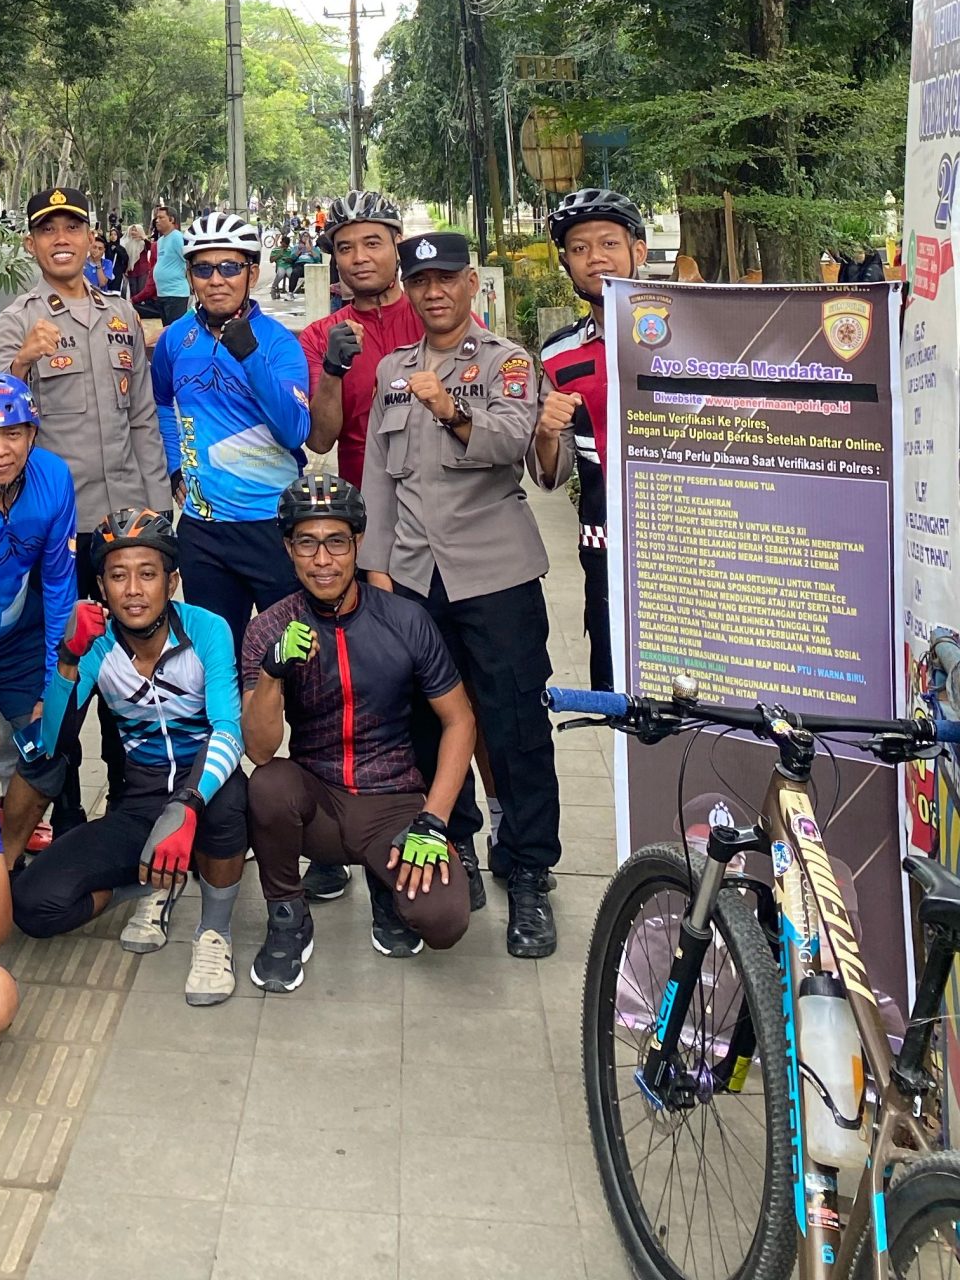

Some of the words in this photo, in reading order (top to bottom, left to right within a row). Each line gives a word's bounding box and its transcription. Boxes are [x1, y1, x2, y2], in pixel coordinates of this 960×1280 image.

[652, 357, 682, 374] Ayo
[686, 359, 746, 378] Segera
[654, 393, 702, 405] Diwebsite
[705, 396, 849, 415] www.penerimaan.polri.go.id
[627, 410, 665, 422] Sebelum
[668, 413, 714, 425] Verifikasi
[718, 416, 731, 426] Ke
[734, 417, 769, 431] Polres,
[627, 424, 660, 438] Jangan
[663, 427, 685, 439] Lupa
[689, 428, 723, 441] Upload
[727, 431, 763, 443] Berkas
[766, 433, 805, 446] Setelah
[810, 436, 841, 449] Daftar
[846, 438, 883, 452] Online.
[628, 446, 660, 458] Berkas
[661, 448, 682, 461] Yang
[685, 450, 710, 462] Perlu
[713, 452, 749, 465] Dibawa
[753, 455, 775, 467] Saat
[778, 457, 824, 471] Verifikasi
[828, 460, 837, 472] di
[839, 461, 872, 475] Polres
[638, 641, 659, 651] SEMUA
[661, 645, 686, 656] BERKAS
[688, 649, 728, 662] DIMASUKKAN
[730, 656, 753, 667] DALAM
[755, 659, 772, 669] MAP
[797, 665, 811, 675] PTU
[818, 668, 844, 680] WARNA
[846, 672, 866, 685] BIRU,
